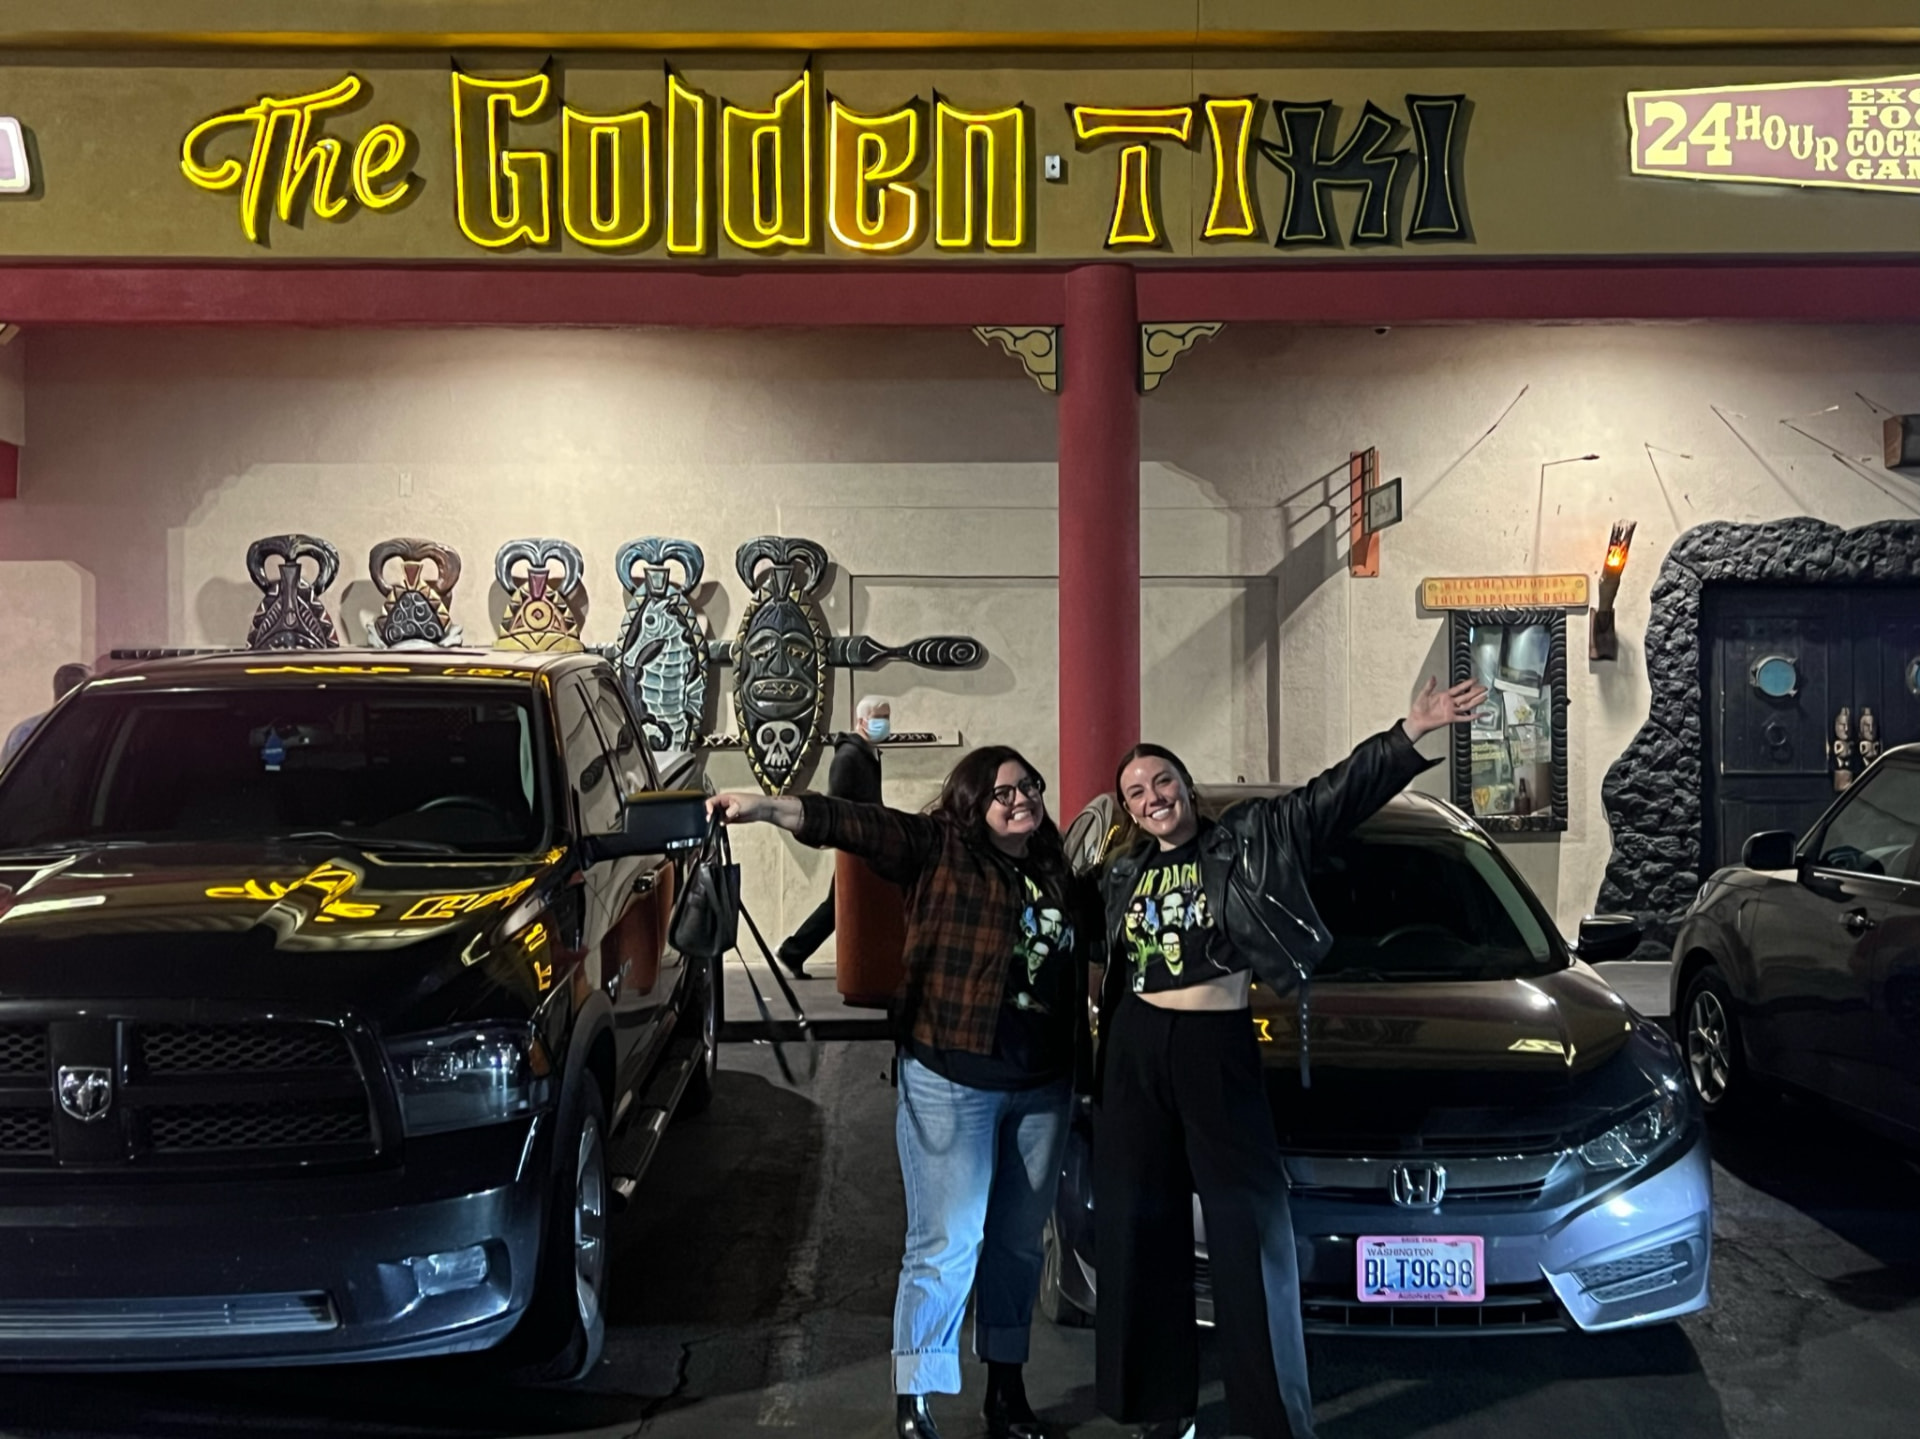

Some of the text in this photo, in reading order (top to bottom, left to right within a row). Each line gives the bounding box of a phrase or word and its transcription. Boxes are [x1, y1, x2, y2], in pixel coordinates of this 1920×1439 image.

[1847, 105, 1920, 129] FO
[1644, 101, 1839, 172] 24 HOUR
[180, 55, 1465, 257] The Golden TIKI
[1366, 1247, 1434, 1257] WASHINGTON
[1365, 1258, 1473, 1289] BLT9698
